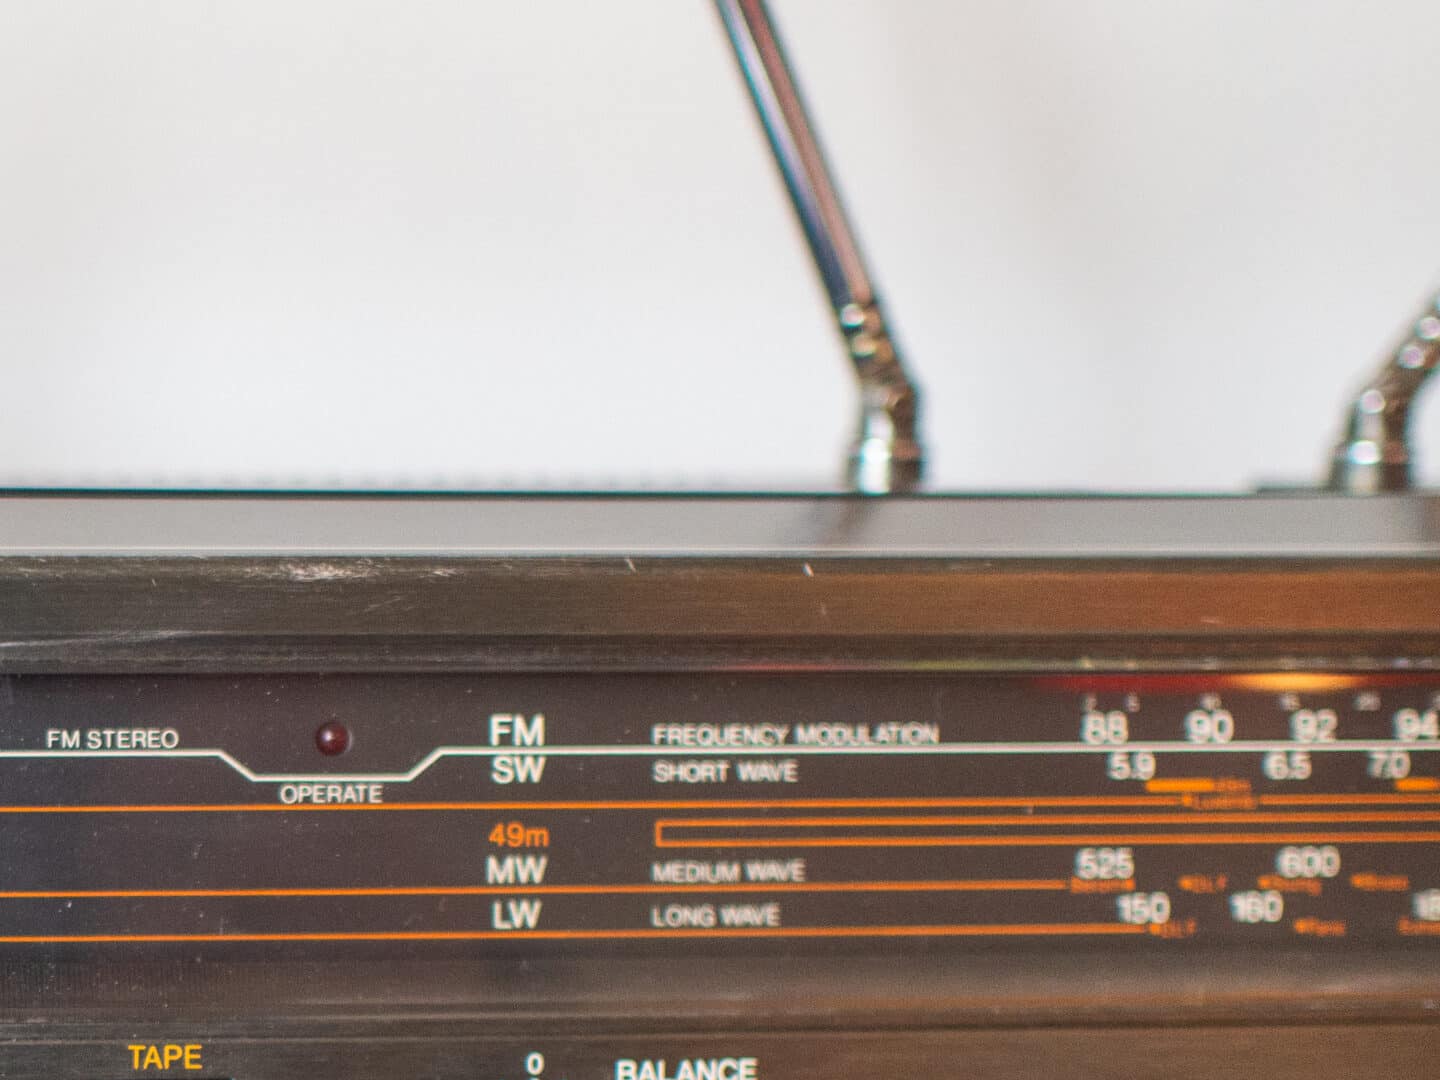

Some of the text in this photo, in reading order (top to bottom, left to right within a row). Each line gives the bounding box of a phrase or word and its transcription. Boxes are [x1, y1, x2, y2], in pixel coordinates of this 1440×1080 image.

[46, 728, 180, 750] FM STEREO
[489, 714, 546, 747] FM
[652, 722, 940, 745] FREQUENCY MODULATION
[1185, 709, 1234, 743] 90
[1290, 708, 1338, 742] 92
[490, 756, 547, 785] SW
[653, 759, 798, 783] SHORT WAVE
[279, 783, 384, 805] OPERATE
[488, 821, 550, 848] 49m
[486, 855, 548, 884] MW
[652, 859, 805, 883] MEDIUM WAVE
[1276, 846, 1341, 878] 600
[491, 899, 543, 930] LW
[652, 904, 781, 928] LONG WAVE
[1116, 892, 1171, 924] 150
[127, 1043, 203, 1070] TAPE
